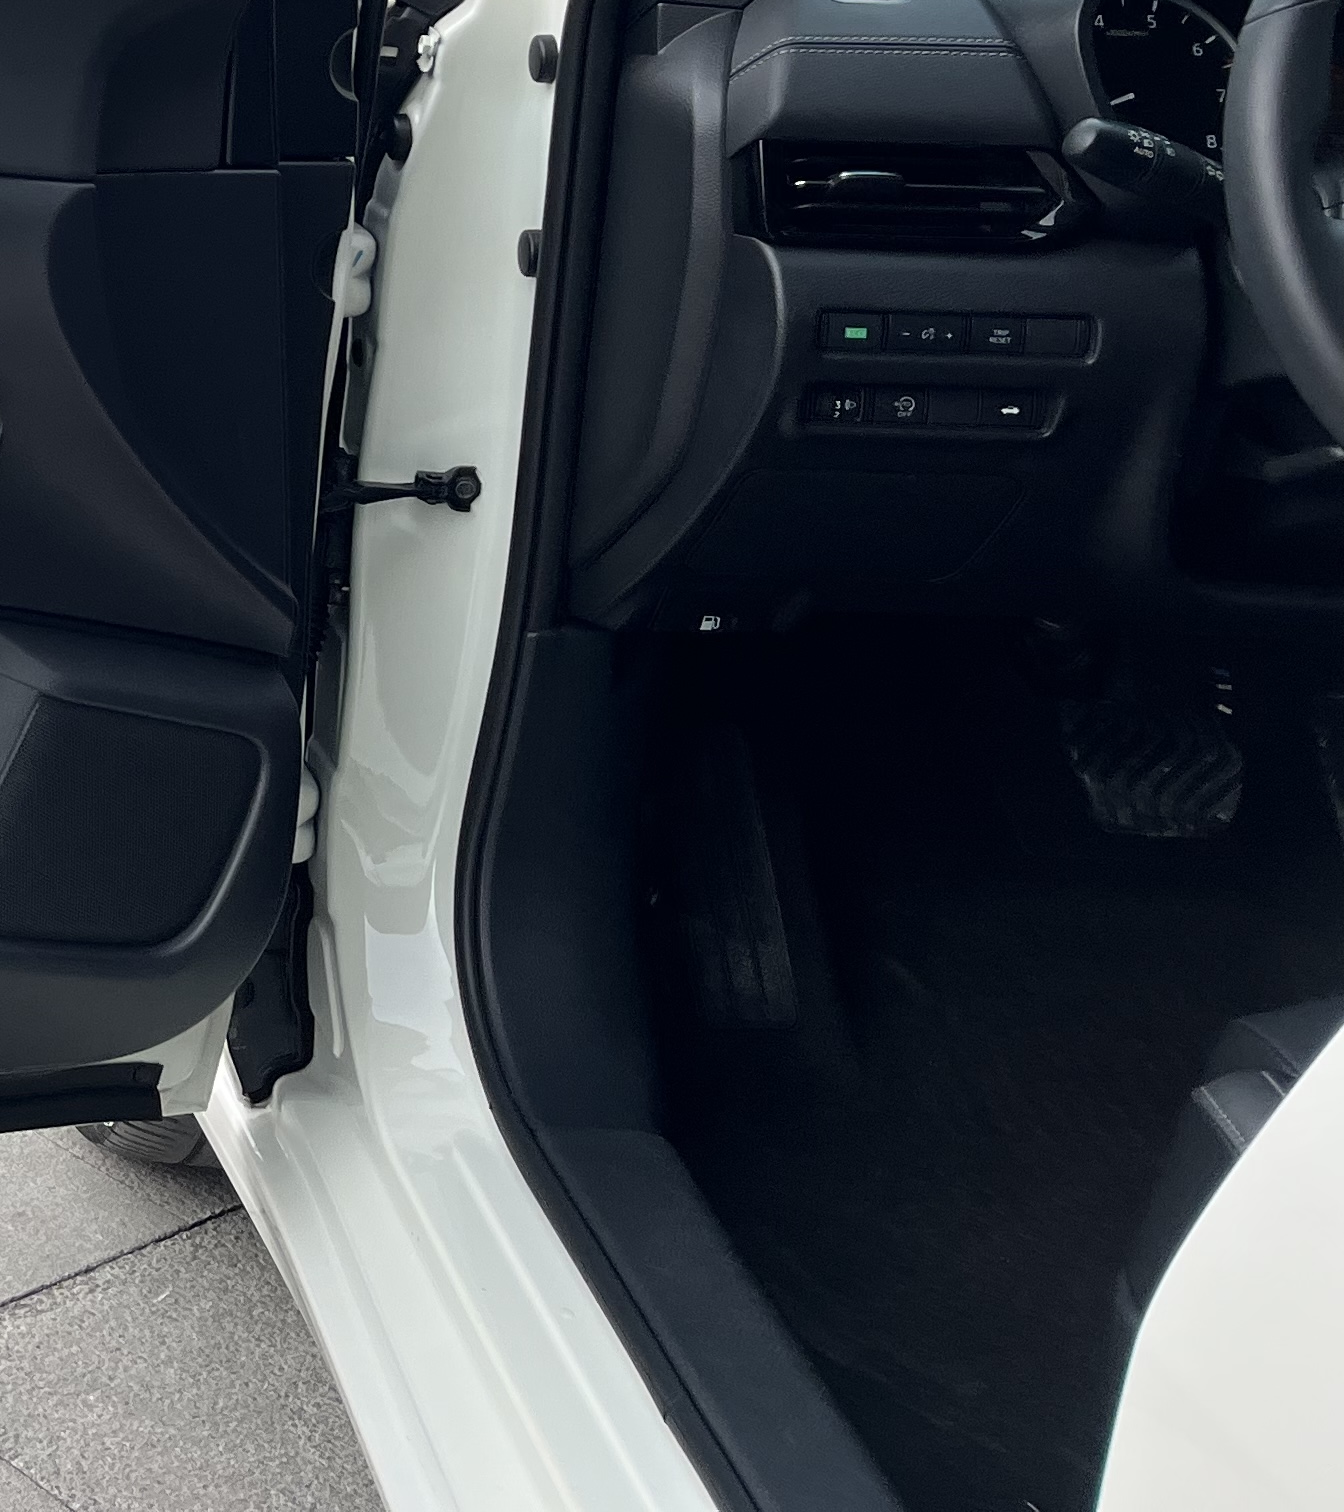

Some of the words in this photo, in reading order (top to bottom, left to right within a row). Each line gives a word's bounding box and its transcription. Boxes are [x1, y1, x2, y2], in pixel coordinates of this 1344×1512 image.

[1094, 14, 1105, 28] 4
[1147, 14, 1157, 29] 5
[1192, 43, 1203, 57] 6
[1216, 88, 1226, 103] 7
[1206, 134, 1217, 149] 8
[1133, 146, 1154, 159] AUTO
